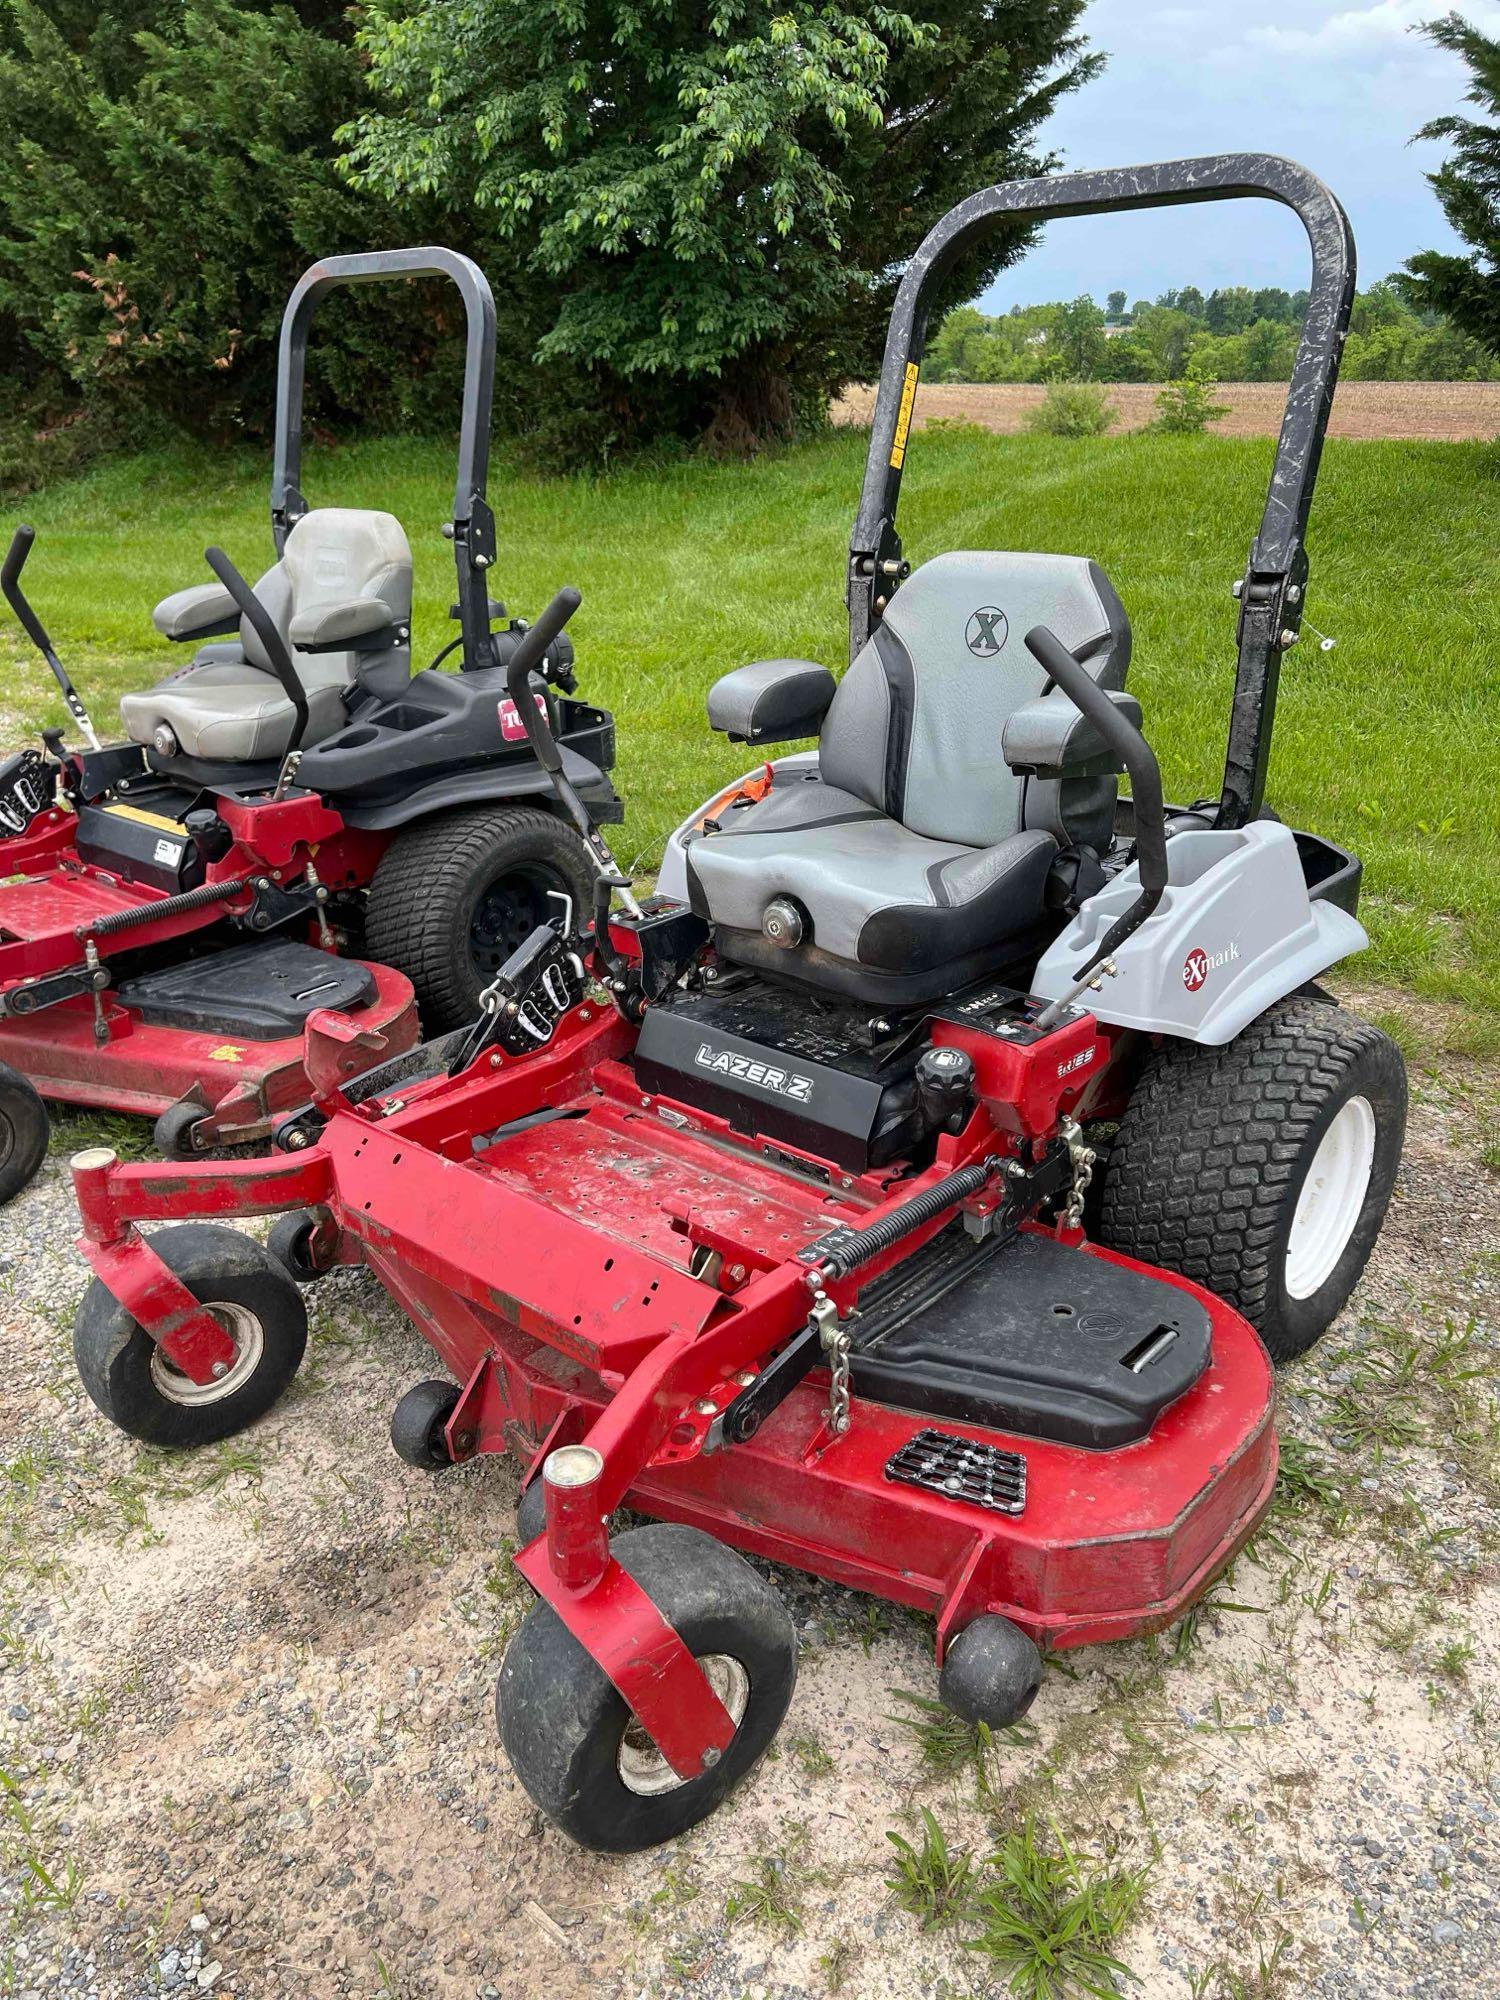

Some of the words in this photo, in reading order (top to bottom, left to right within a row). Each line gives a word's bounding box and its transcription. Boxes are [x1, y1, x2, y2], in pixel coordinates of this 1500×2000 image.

[969, 613, 1003, 649] X
[1183, 942, 1239, 986] eXmark
[696, 1045, 786, 1092] LAZER
[786, 1076, 812, 1100] Z
